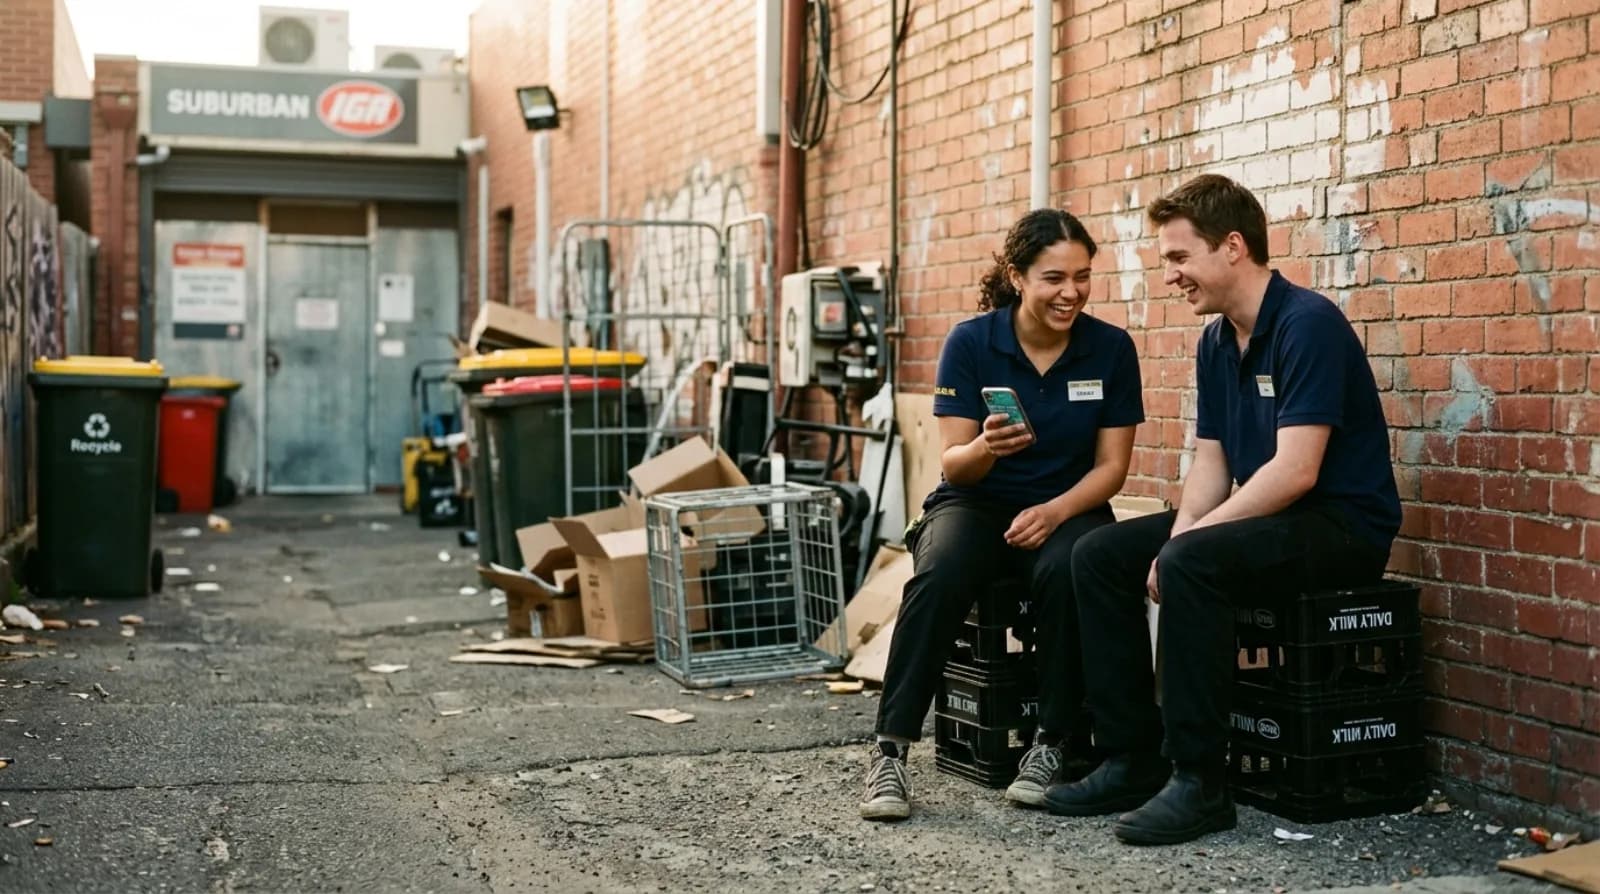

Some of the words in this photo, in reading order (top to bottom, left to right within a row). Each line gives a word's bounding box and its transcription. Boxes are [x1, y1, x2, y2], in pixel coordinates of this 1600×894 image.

[167, 88, 310, 119] SUBURBAN
[71, 438, 122, 456] Recycle
[1328, 615, 1358, 632] MILK
[1359, 611, 1393, 630] DAILY
[1331, 726, 1362, 744] MILK
[1362, 722, 1397, 741] DAILY
